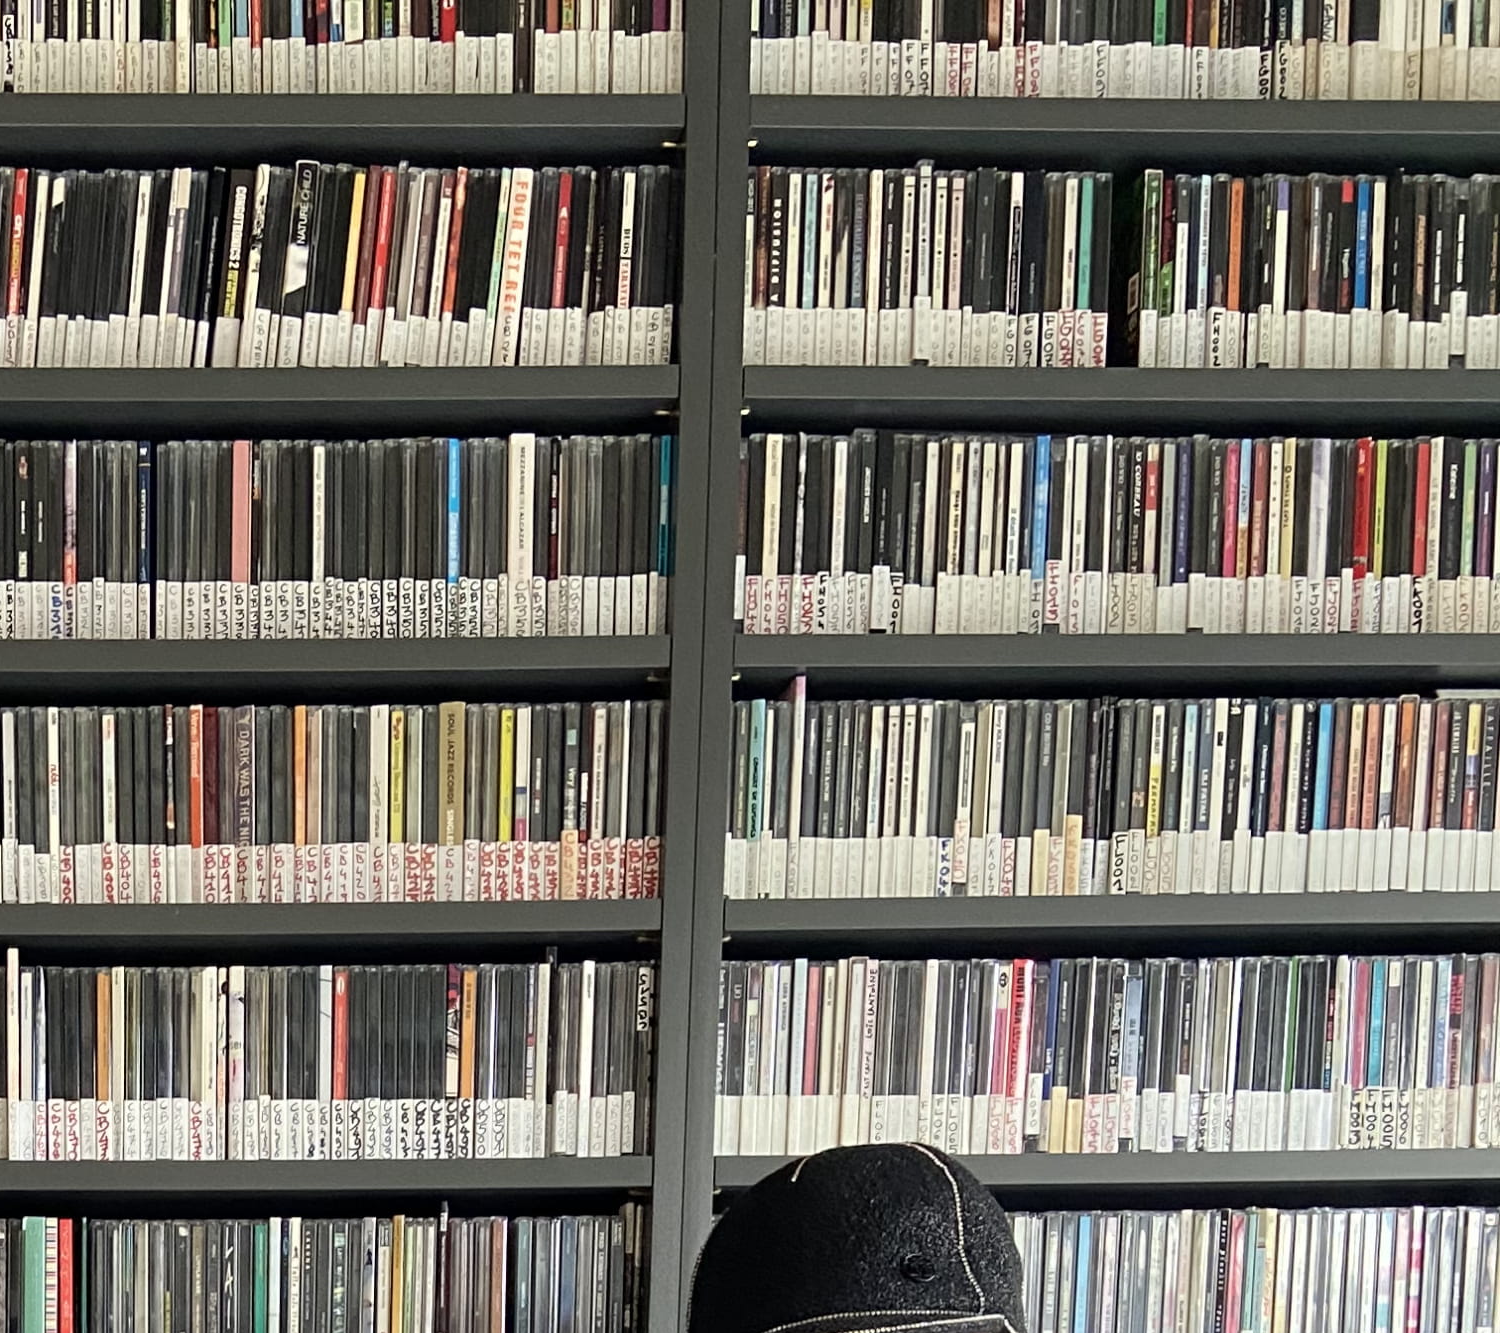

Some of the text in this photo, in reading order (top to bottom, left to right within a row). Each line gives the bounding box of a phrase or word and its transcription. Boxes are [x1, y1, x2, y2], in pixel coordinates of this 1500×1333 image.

[1258, 54, 1270, 99] FG00
[231, 186, 247, 261] CONGOTRONICS
[295, 169, 313, 244] NATURE CHILD
[513, 180, 529, 233] FOUR
[508, 240, 523, 272] TET
[446, 713, 456, 737] SOUL
[238, 731, 251, 766] DARK
[446, 739, 456, 762] JAZZ
[238, 768, 251, 797] WAS
[446, 764, 456, 805] RECORDS
[238, 799, 251, 824] THE
